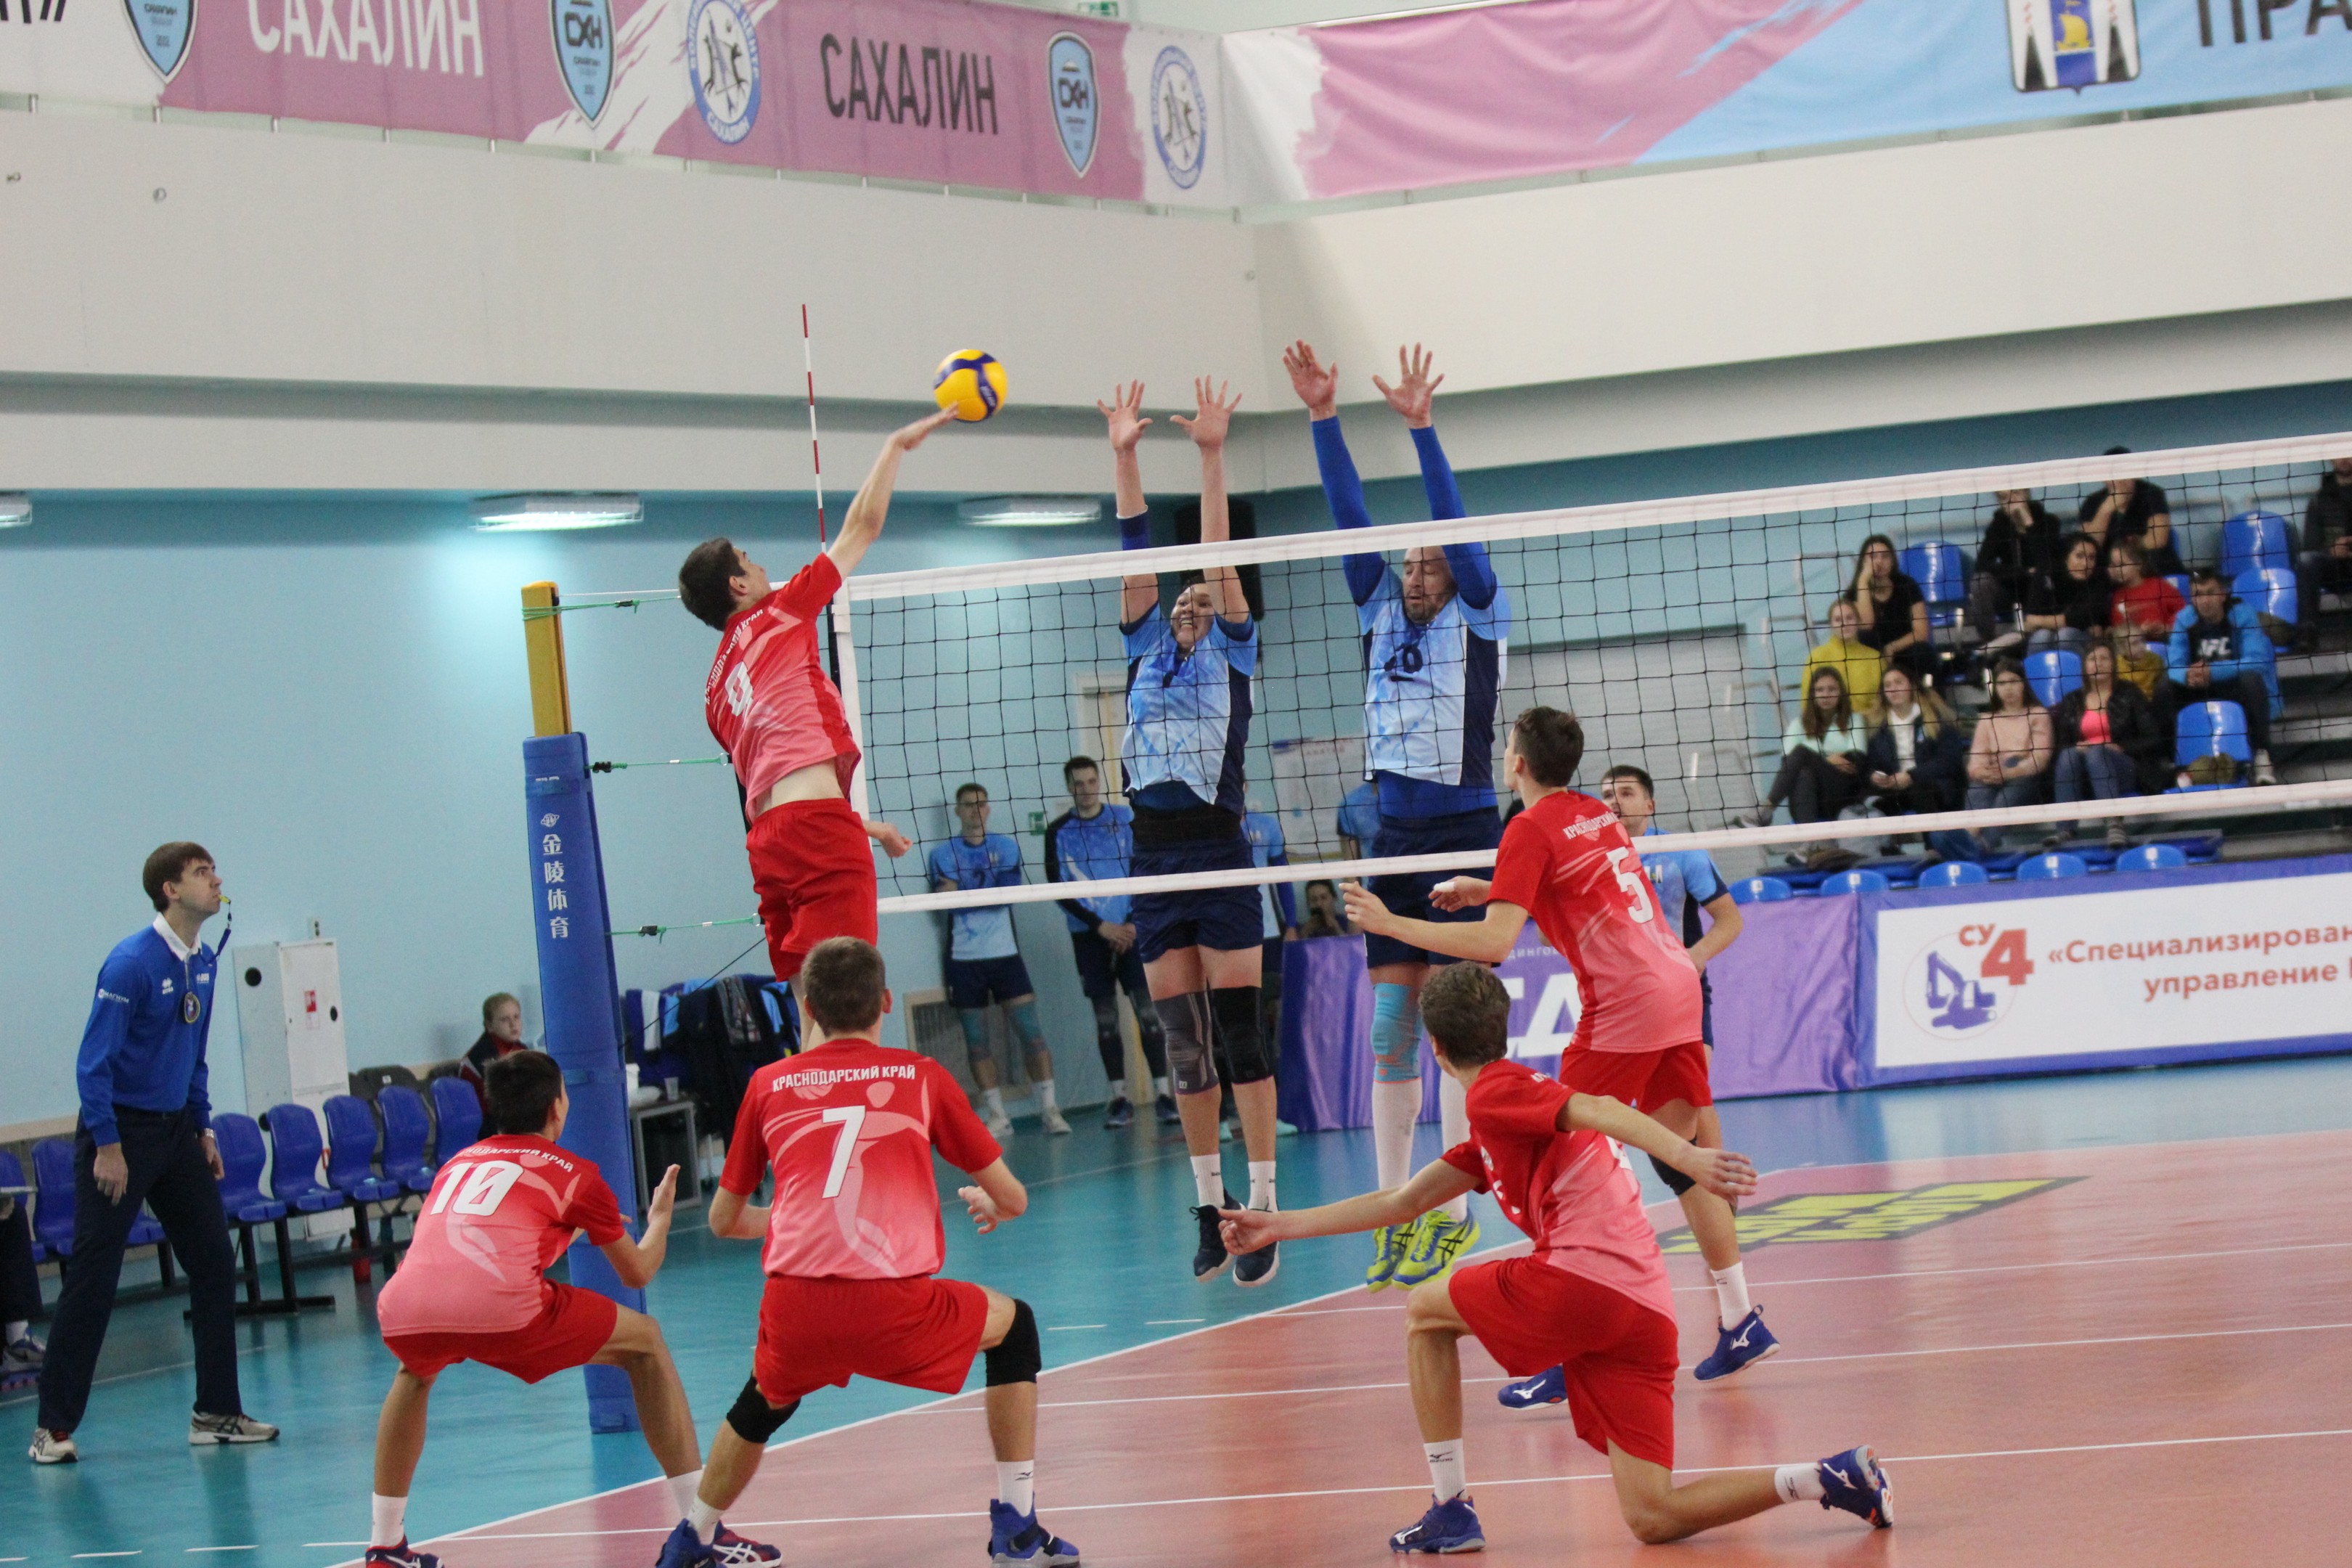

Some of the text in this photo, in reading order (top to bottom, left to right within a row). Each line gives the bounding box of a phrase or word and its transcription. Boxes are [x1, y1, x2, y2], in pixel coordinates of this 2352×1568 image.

[820, 33, 999, 135] САХАЛИН
[542, 833, 570, 939] 金陵体育
[1606, 846, 1654, 924] 5
[1959, 923, 2034, 986] СУ 4
[2144, 964, 2338, 1002] управление
[773, 1064, 916, 1093] КРАСНОДАРСКИЙ КРАЙ
[541, 1152, 574, 1173] КРАЙ
[822, 1105, 866, 1199] 7
[430, 1160, 524, 1217] 10
